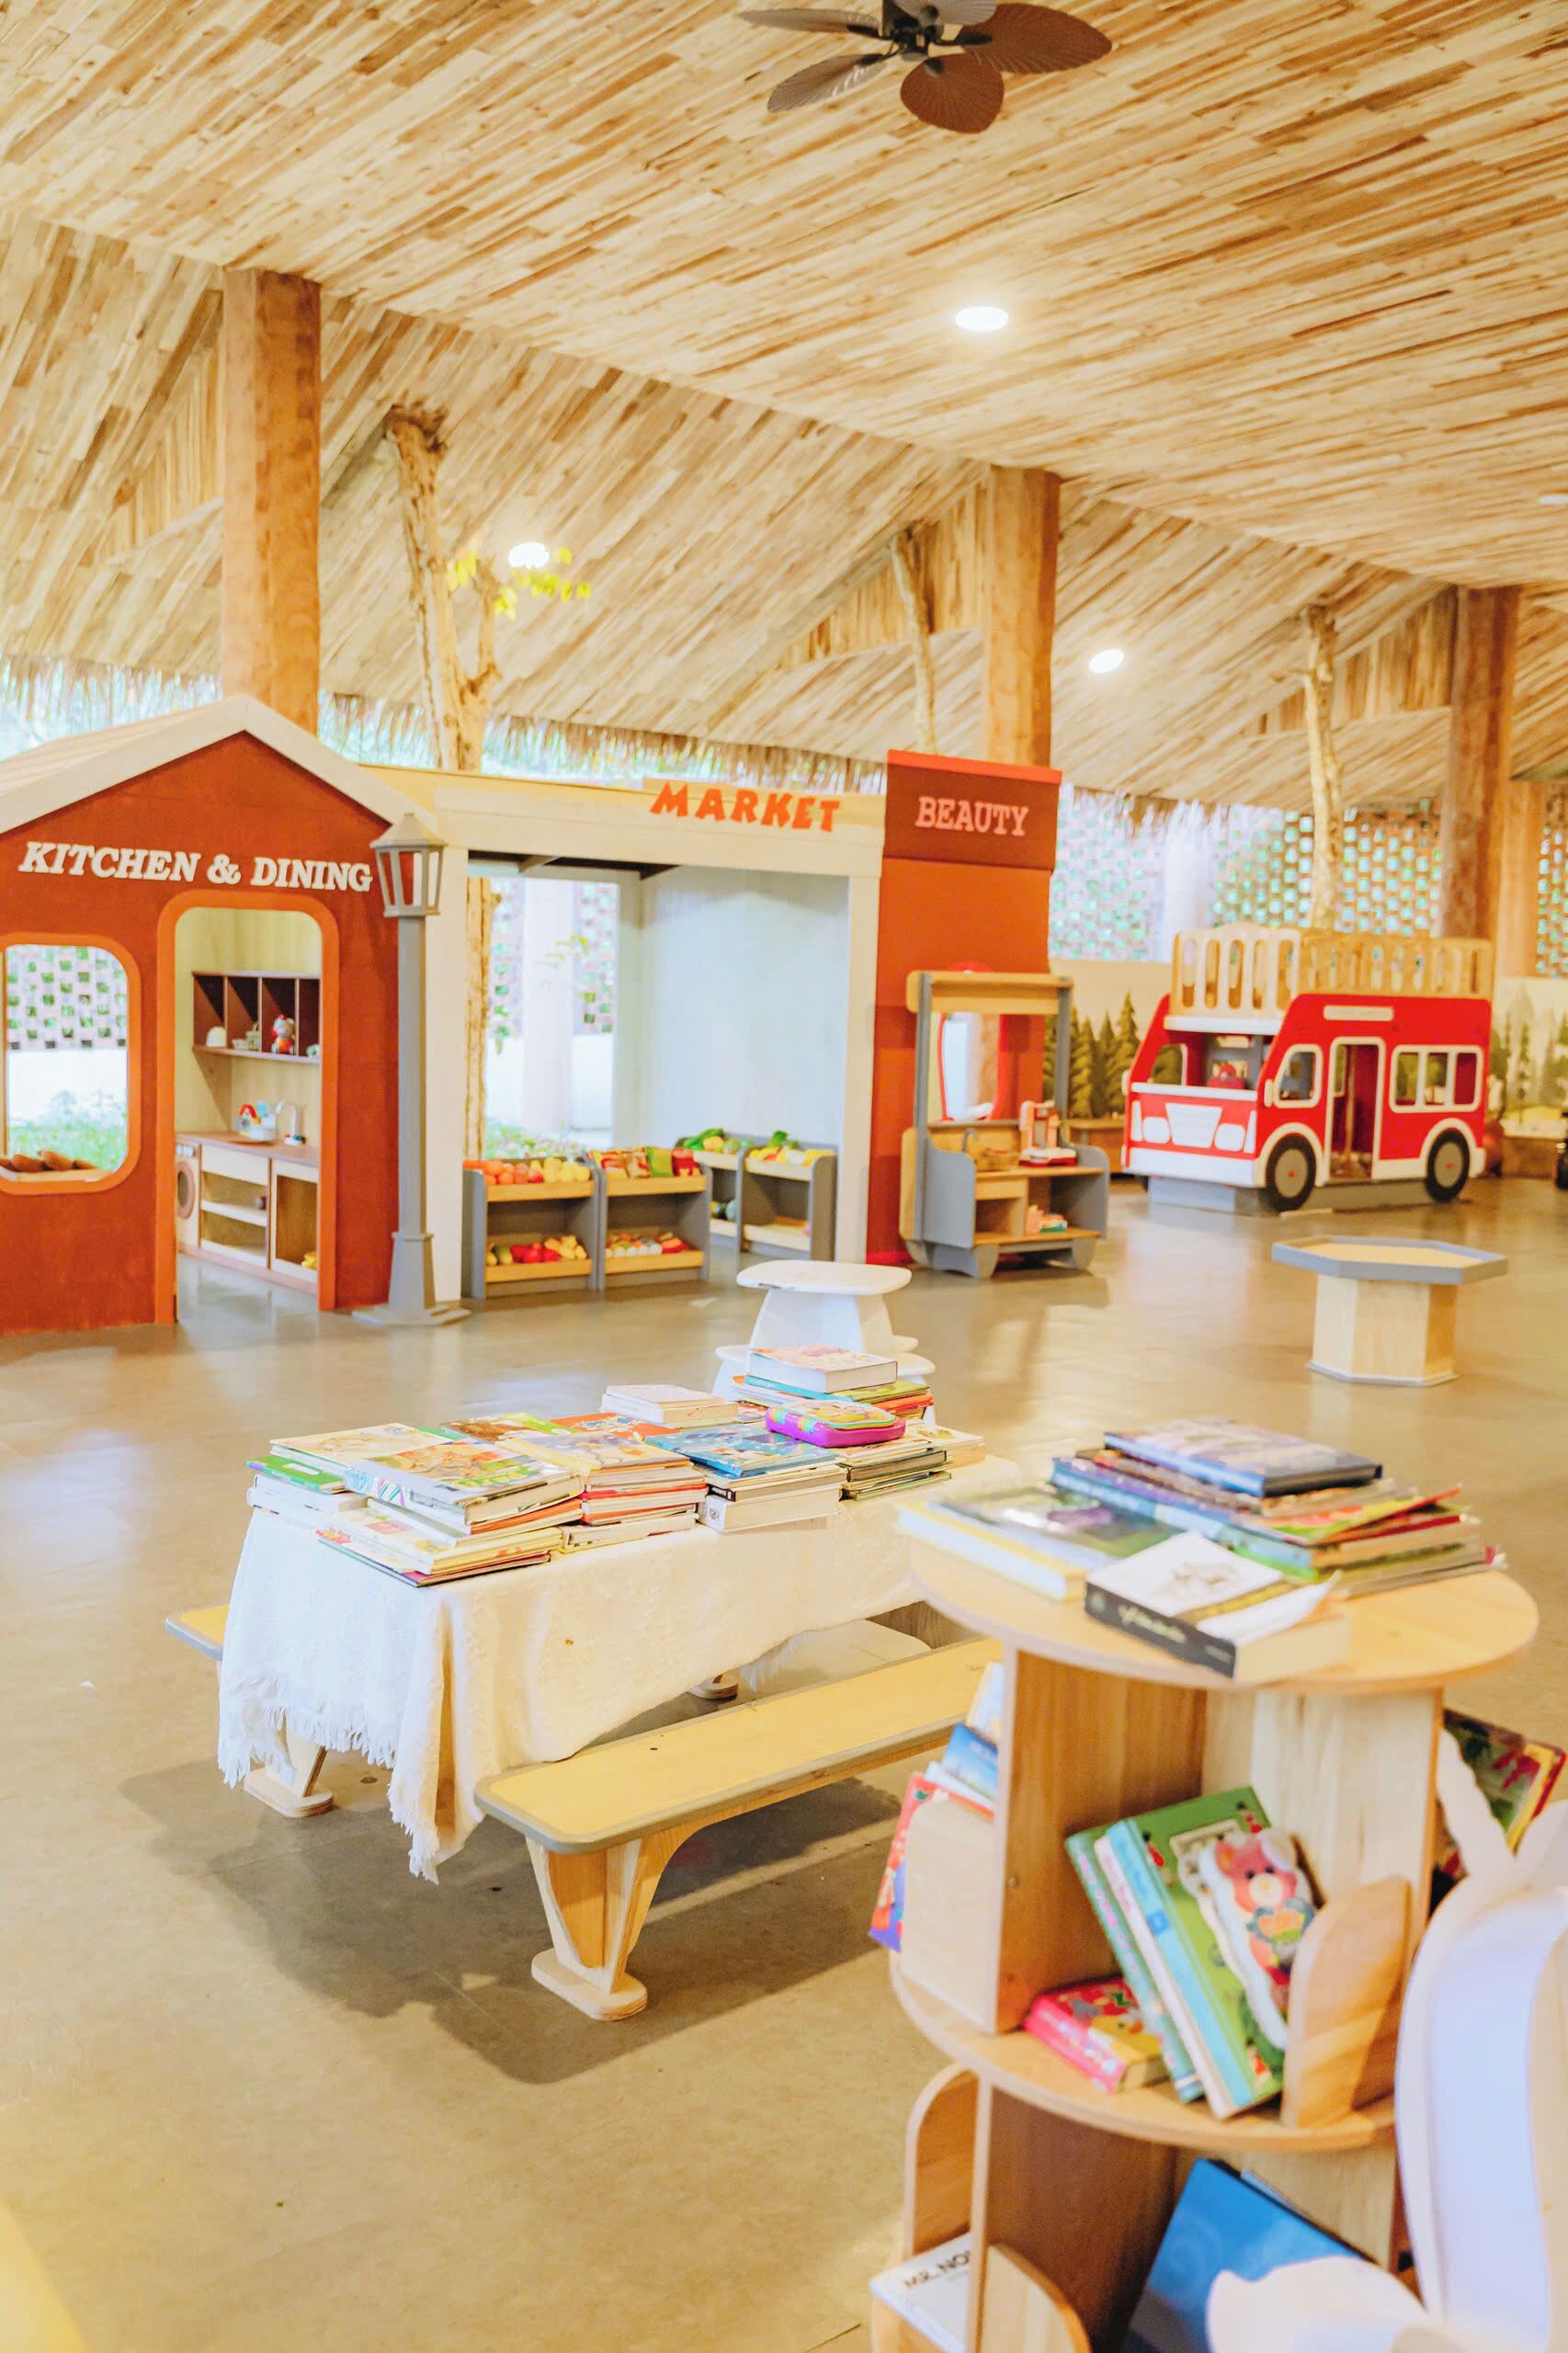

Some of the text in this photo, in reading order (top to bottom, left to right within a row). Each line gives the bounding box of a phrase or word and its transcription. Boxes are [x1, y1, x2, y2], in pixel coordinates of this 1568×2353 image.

[650, 782, 840, 833] MARKET
[915, 796, 1028, 836] BEAUTY
[17, 841, 373, 892] KITCHEN & DINING
